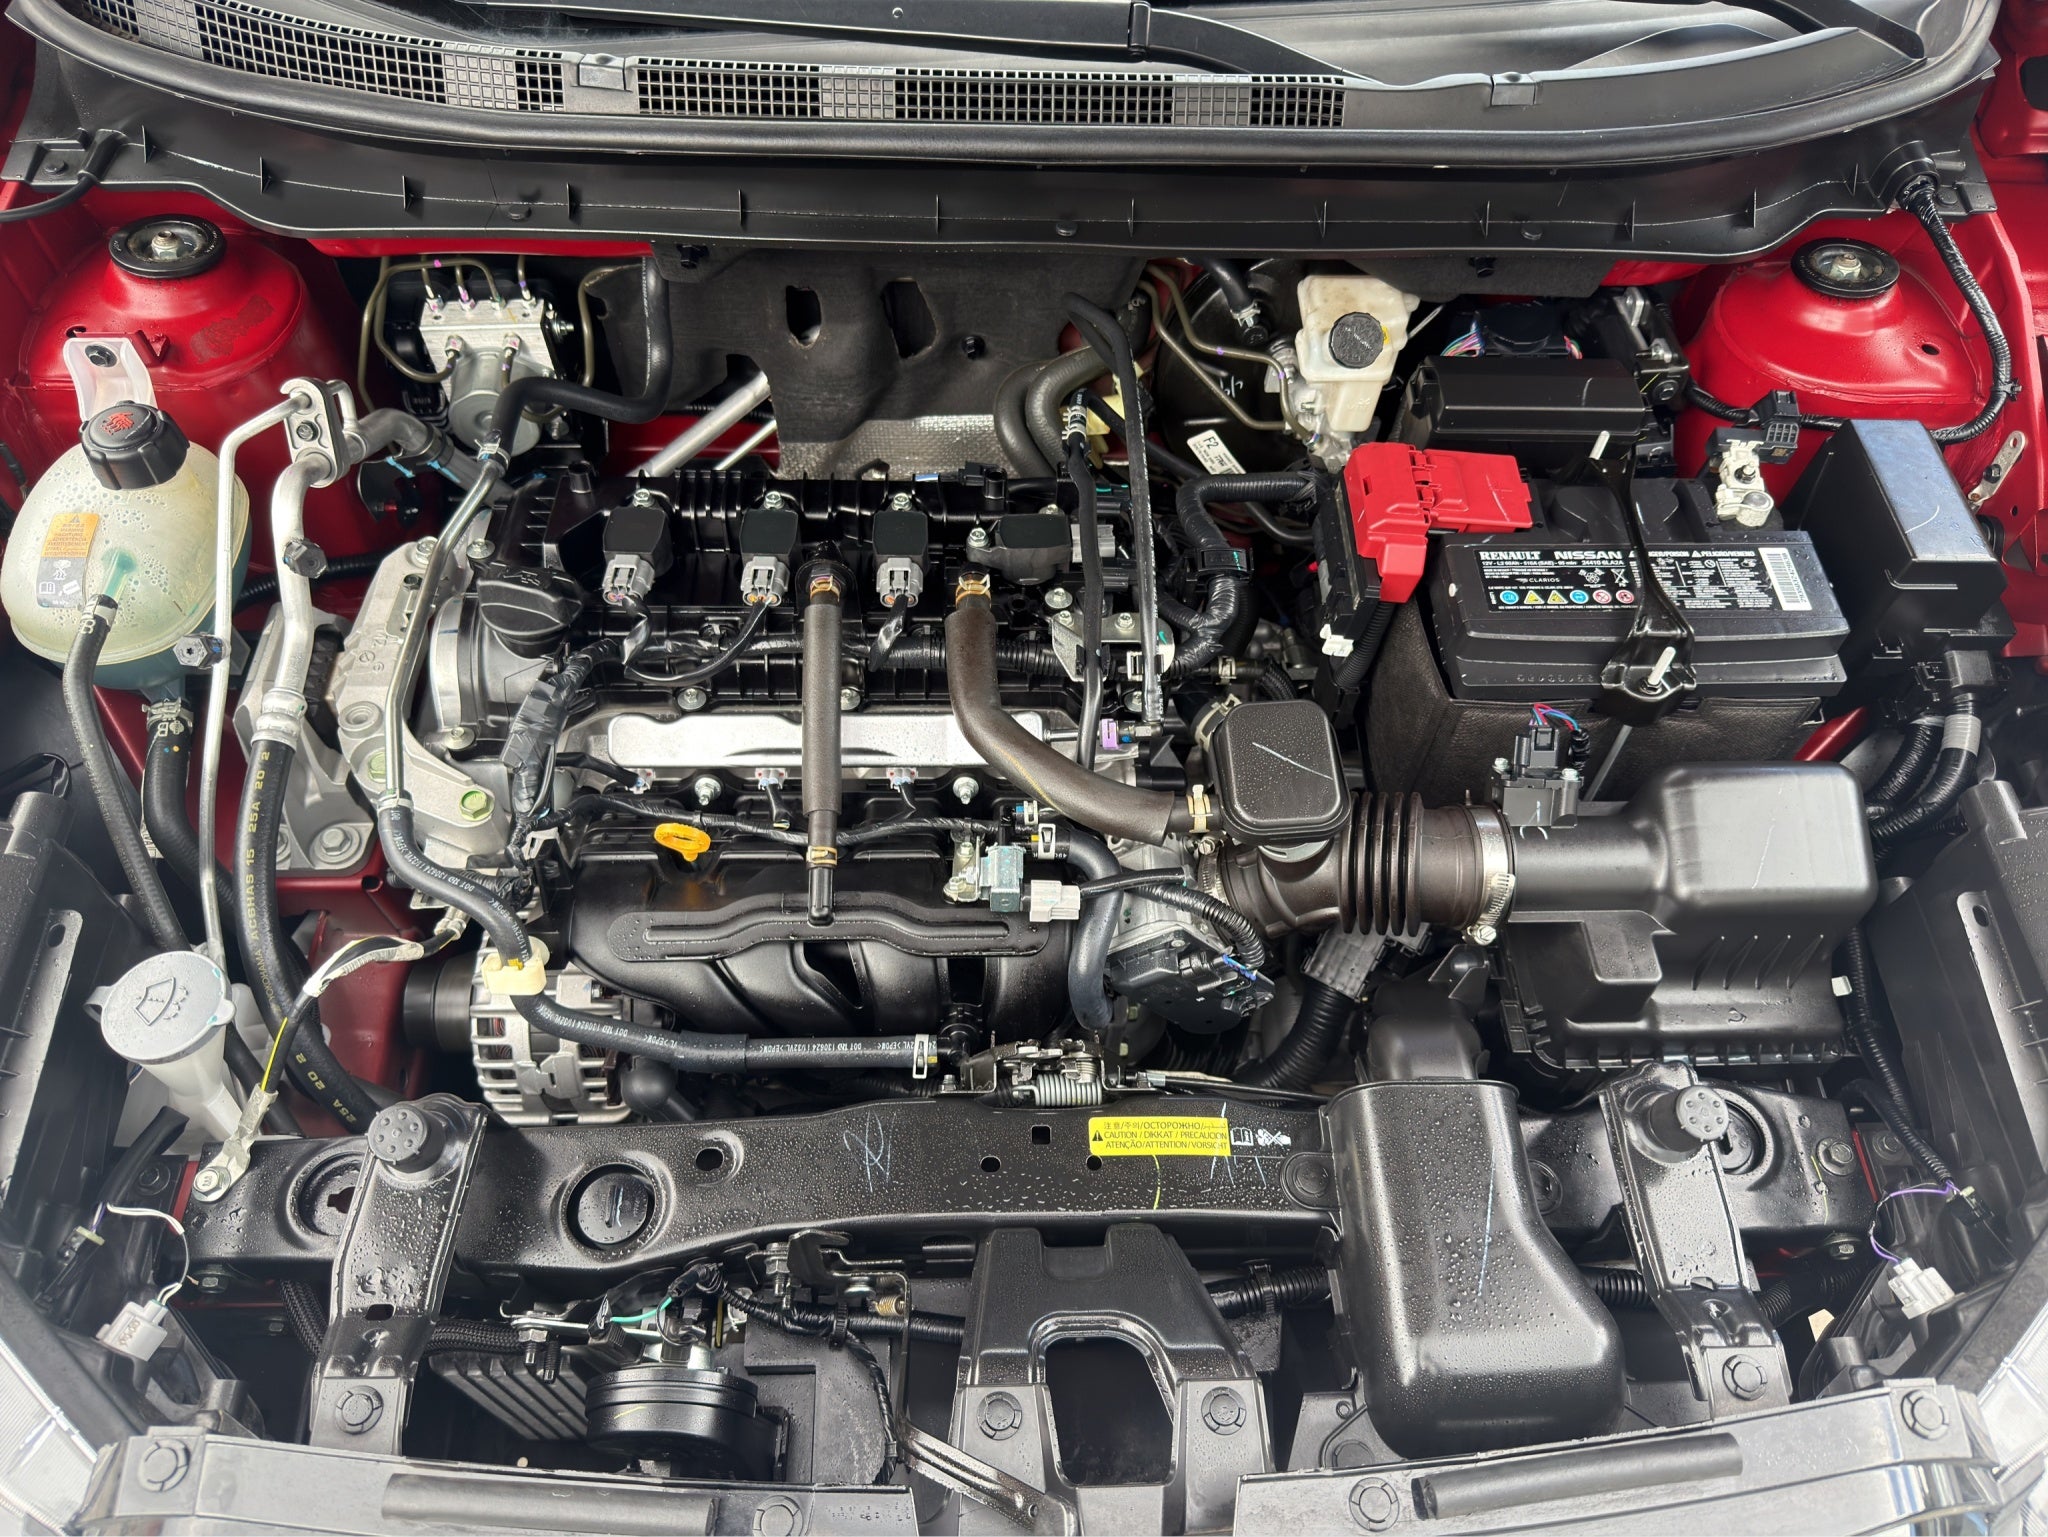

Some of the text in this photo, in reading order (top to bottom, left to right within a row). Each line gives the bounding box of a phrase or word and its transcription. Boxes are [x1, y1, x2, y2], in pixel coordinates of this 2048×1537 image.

[1203, 436, 1219, 449] F2
[1479, 551, 1622, 560] RENAULT NISSAN
[248, 801, 261, 833] 25A
[255, 948, 275, 1002] YOKOHAMA
[333, 1098, 357, 1123] 25A
[1104, 1131, 1138, 1139] CAUTION
